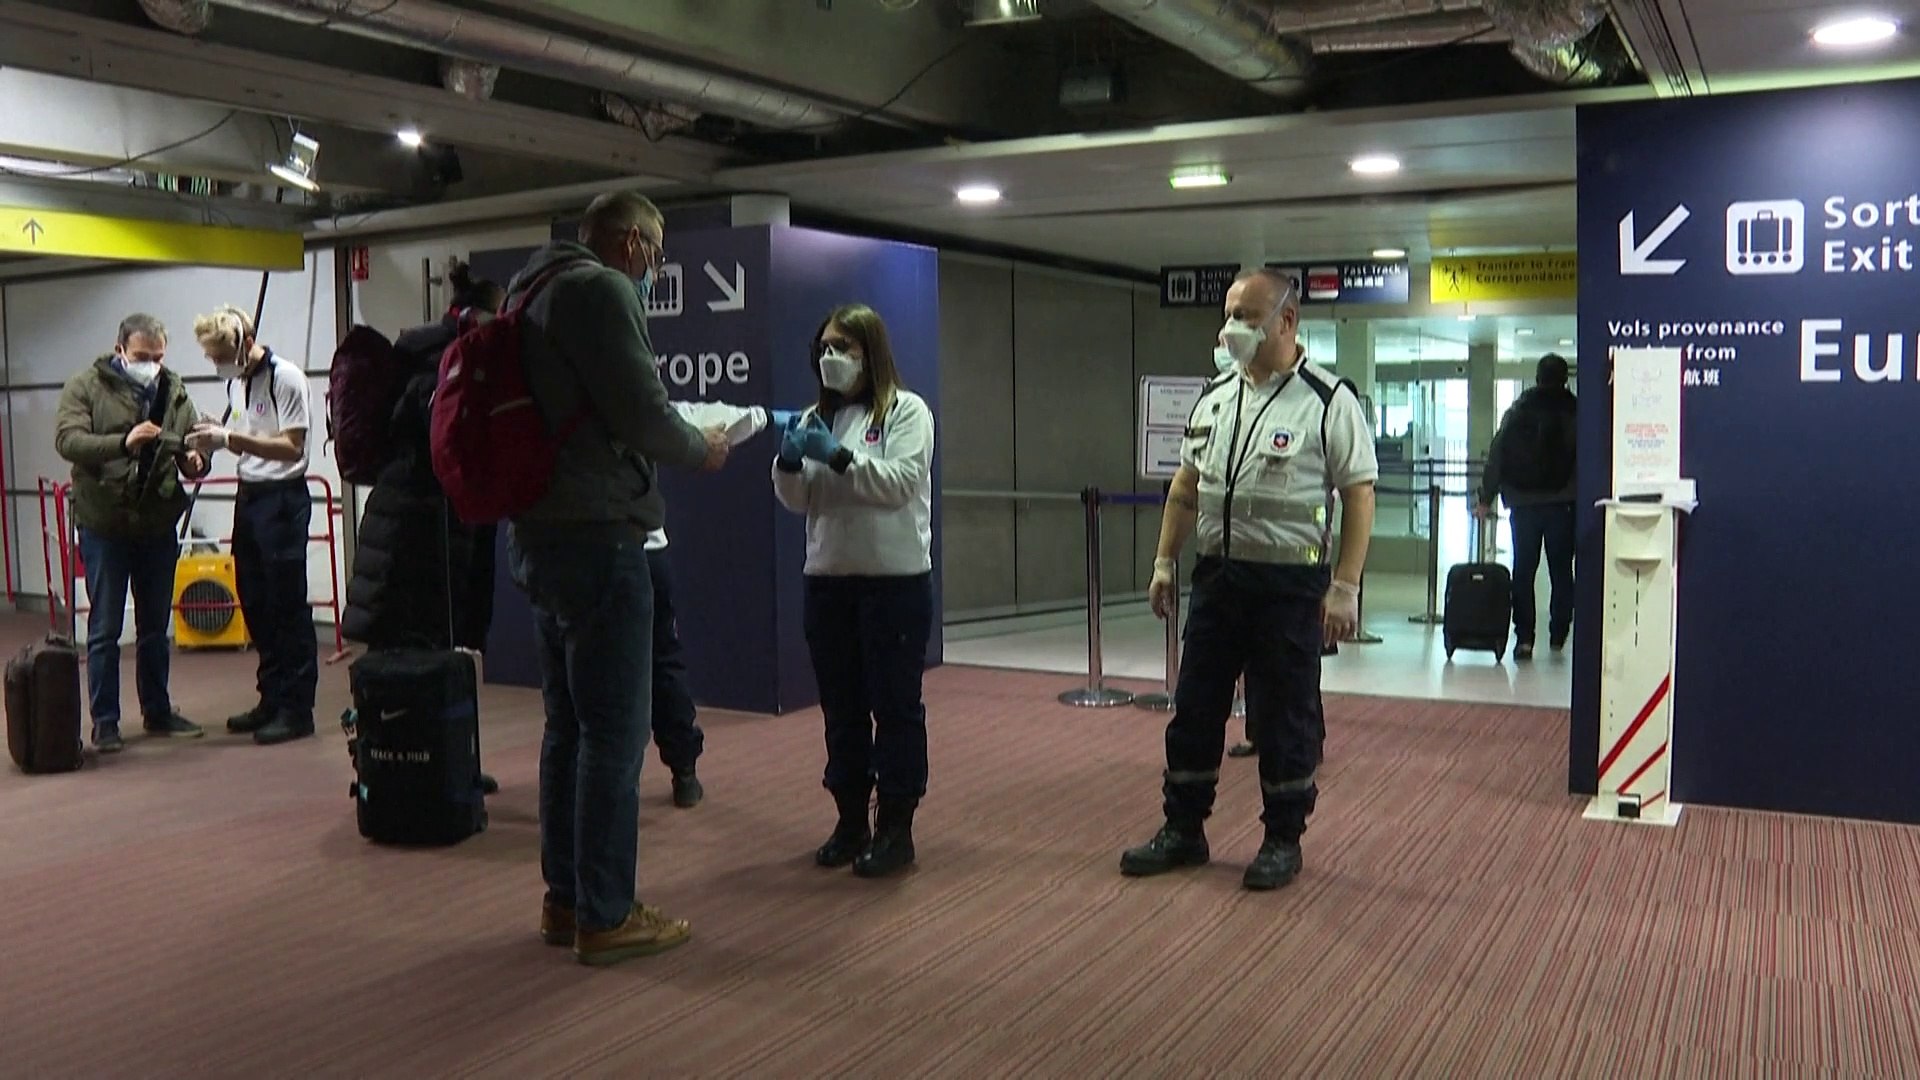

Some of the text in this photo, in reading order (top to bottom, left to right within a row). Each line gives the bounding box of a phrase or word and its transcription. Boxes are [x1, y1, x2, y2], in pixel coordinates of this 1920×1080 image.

[1823, 237, 1913, 273] Exit
[1343, 264, 1367, 275] Fast
[1477, 260, 1525, 271] Transfer
[1531, 259, 1543, 269] to
[1608, 319, 1785, 340] Vols provenance
[1686, 343, 1736, 361] from
[1800, 318, 1920, 383] Eu
